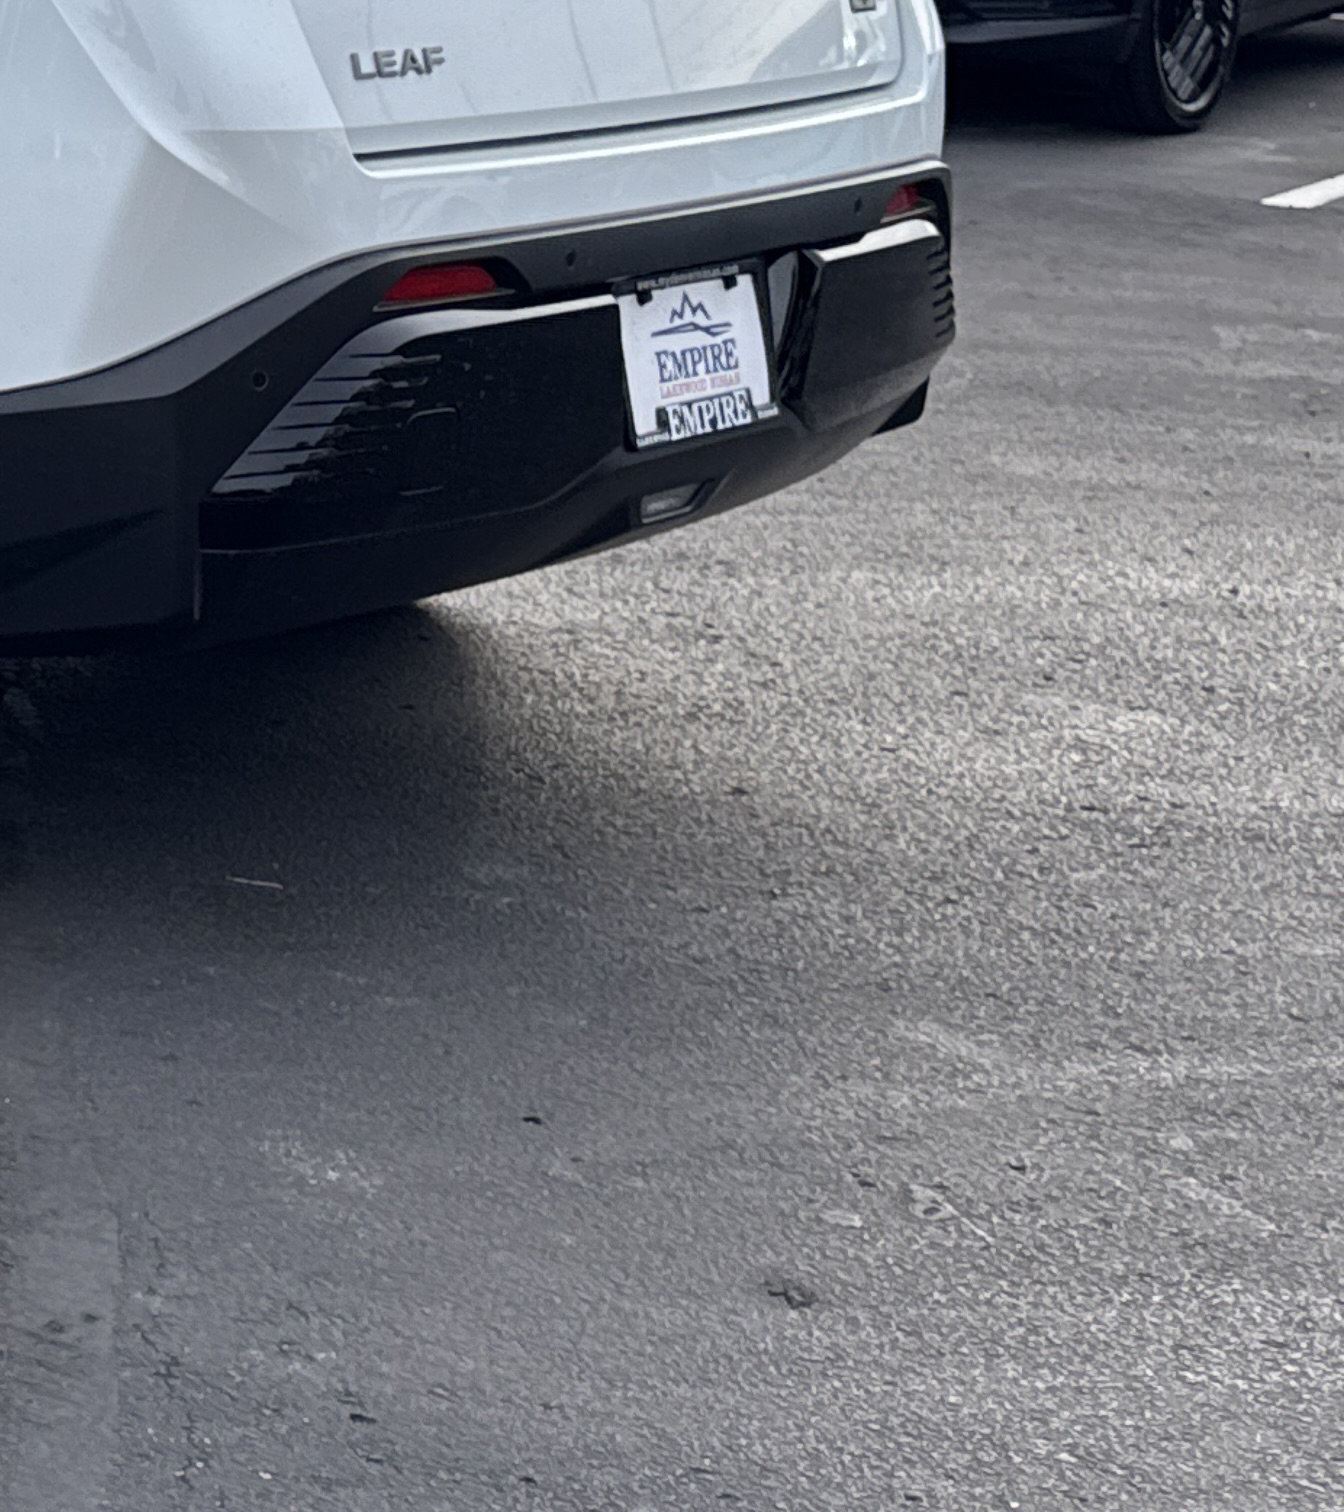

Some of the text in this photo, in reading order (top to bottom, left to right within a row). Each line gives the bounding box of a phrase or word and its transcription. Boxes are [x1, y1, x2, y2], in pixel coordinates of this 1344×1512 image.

[350, 46, 446, 82] LEAF
[654, 338, 740, 384] EMPIRE
[665, 389, 753, 442] EMPIRE
